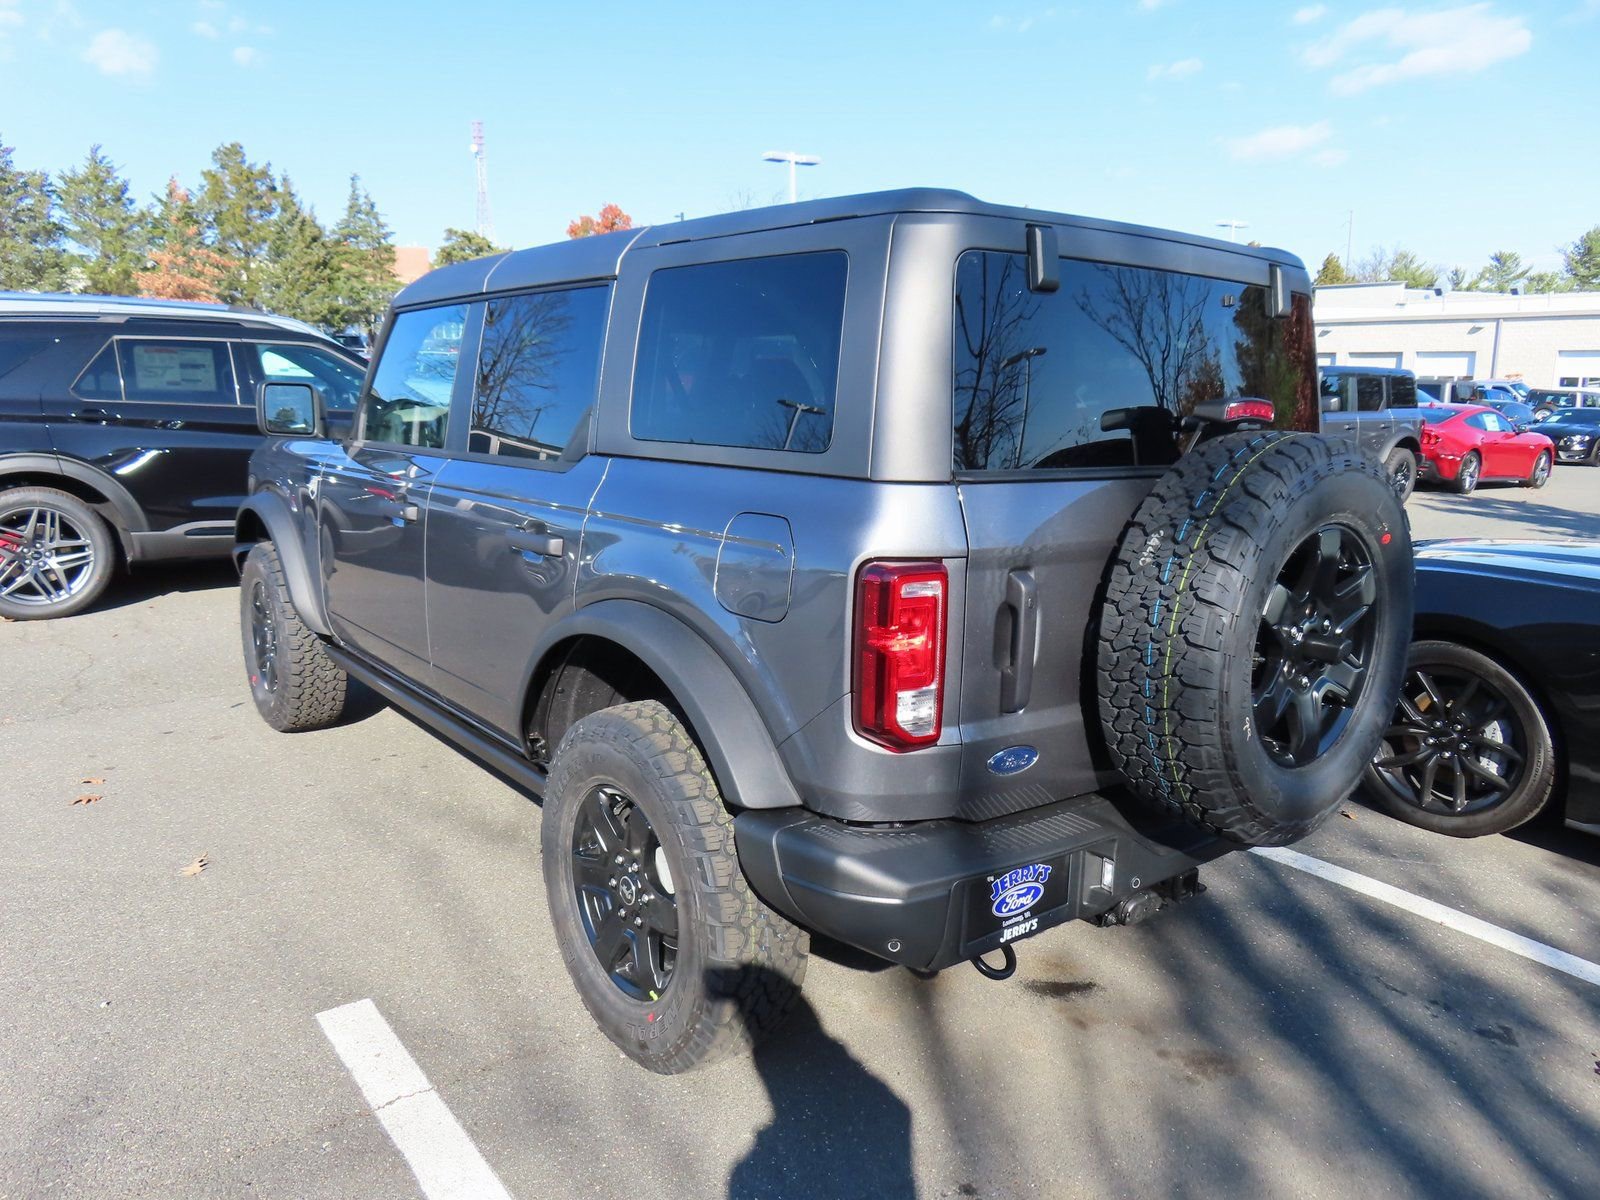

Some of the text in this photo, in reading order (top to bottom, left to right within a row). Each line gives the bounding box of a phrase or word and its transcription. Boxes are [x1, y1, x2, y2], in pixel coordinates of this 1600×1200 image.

[990, 863, 1052, 901] JERRY'S
[1002, 888, 1034, 912] Ford
[1000, 918, 1038, 943] JERRY'S
